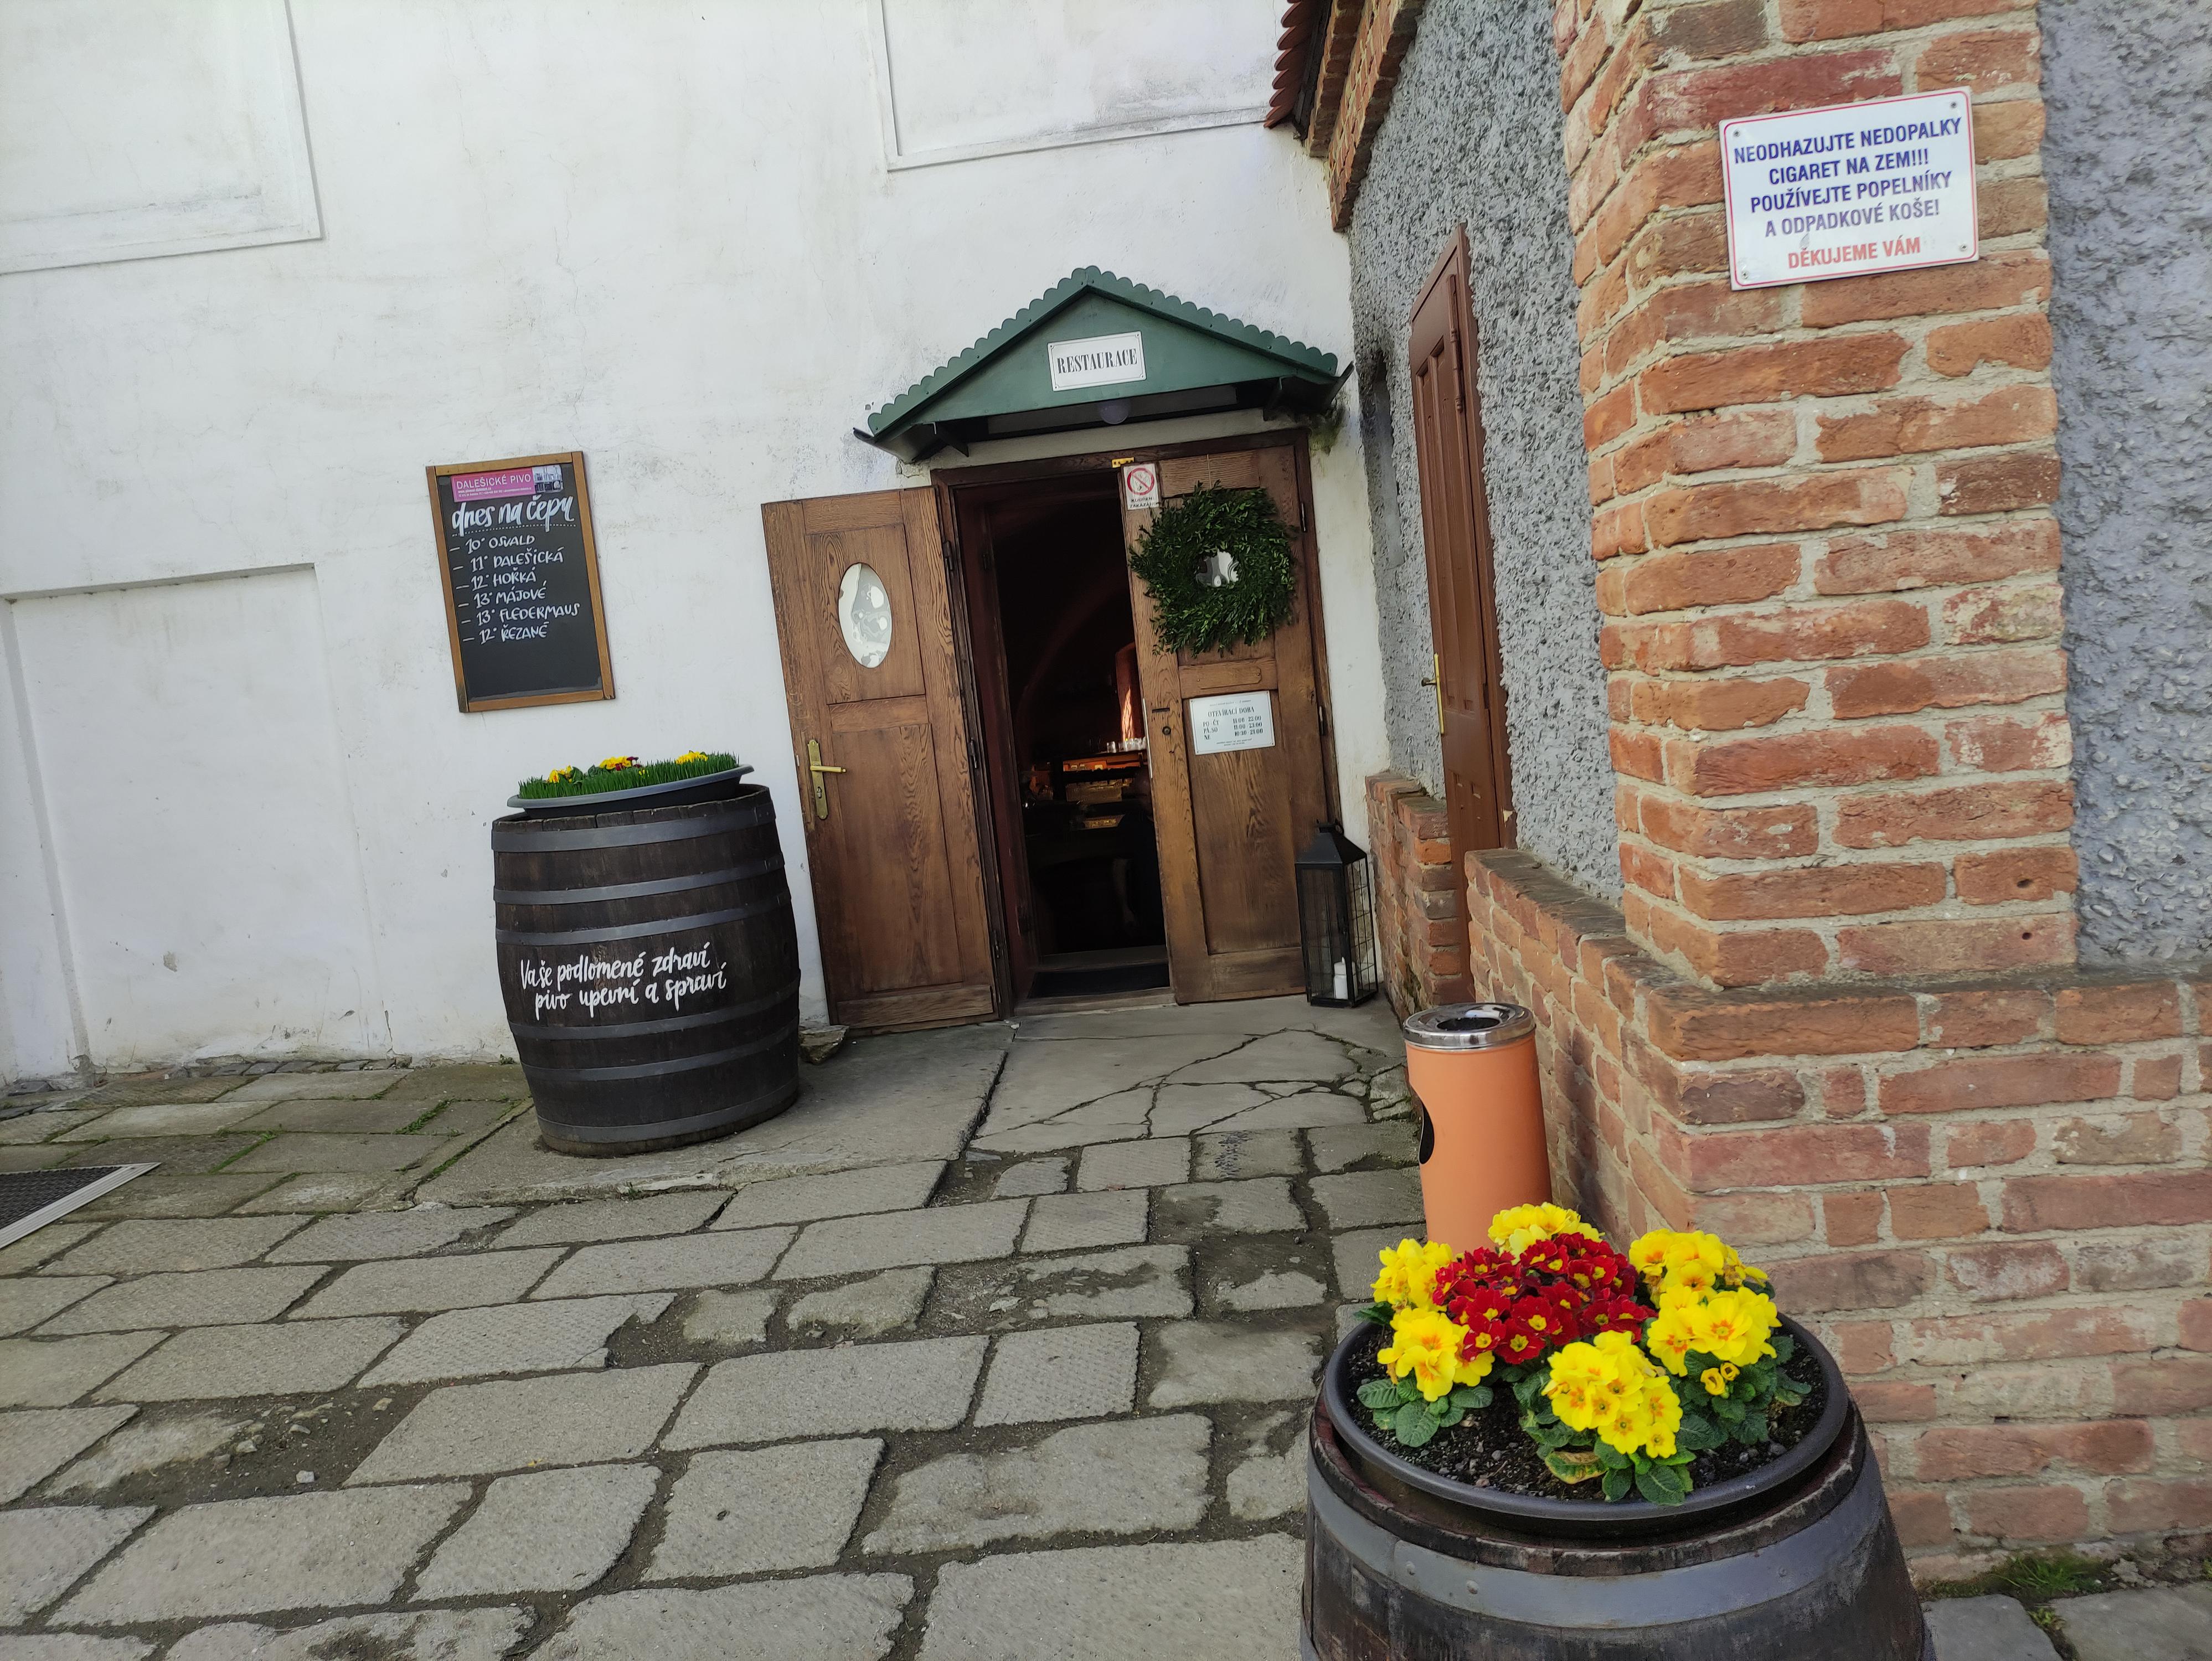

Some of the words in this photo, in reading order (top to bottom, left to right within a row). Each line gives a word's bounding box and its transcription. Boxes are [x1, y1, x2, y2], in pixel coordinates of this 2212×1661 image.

[1734, 132, 1855, 164] NEODHAZUJTE
[1860, 116, 1962, 147] NEDOPALKY
[1769, 159, 1841, 185] CIGARET
[1846, 157, 1870, 175] NA
[1874, 148, 1929, 166] ZEM!!!
[1751, 185, 1852, 213] POUŽÍVEJTE
[1857, 169, 1952, 200] POPELNÍKY
[1765, 220, 1776, 238] A
[1781, 203, 1884, 235] ODPADKOVÉ
[1889, 198, 1940, 218] KOŠE!
[1788, 243, 1878, 269] DĚKUJEME
[1882, 235, 1921, 257] VÁM
[1056, 348, 1138, 374] RESTAURACE
[456, 474, 508, 489] DALEŠICKÉ
[510, 473, 532, 484] PIVO
[452, 502, 496, 537] dnes
[498, 502, 524, 525] na
[526, 494, 575, 533] čepu
[488, 534, 535, 549] OSVALD
[493, 566, 537, 587] HOŘKÁ
[495, 580, 547, 605] MÁJOVÉ
[499, 602, 581, 623] FLEDERMAUS
[501, 621, 550, 643] ŘEZANÉ
[520, 957, 553, 989] Vaše
[557, 951, 647, 992] podlomené
[651, 941, 711, 977] zdraví
[535, 988, 573, 1020] pivo
[579, 978, 641, 1018] upevní
[644, 983, 659, 1003] a
[665, 962, 727, 1012] spraví
